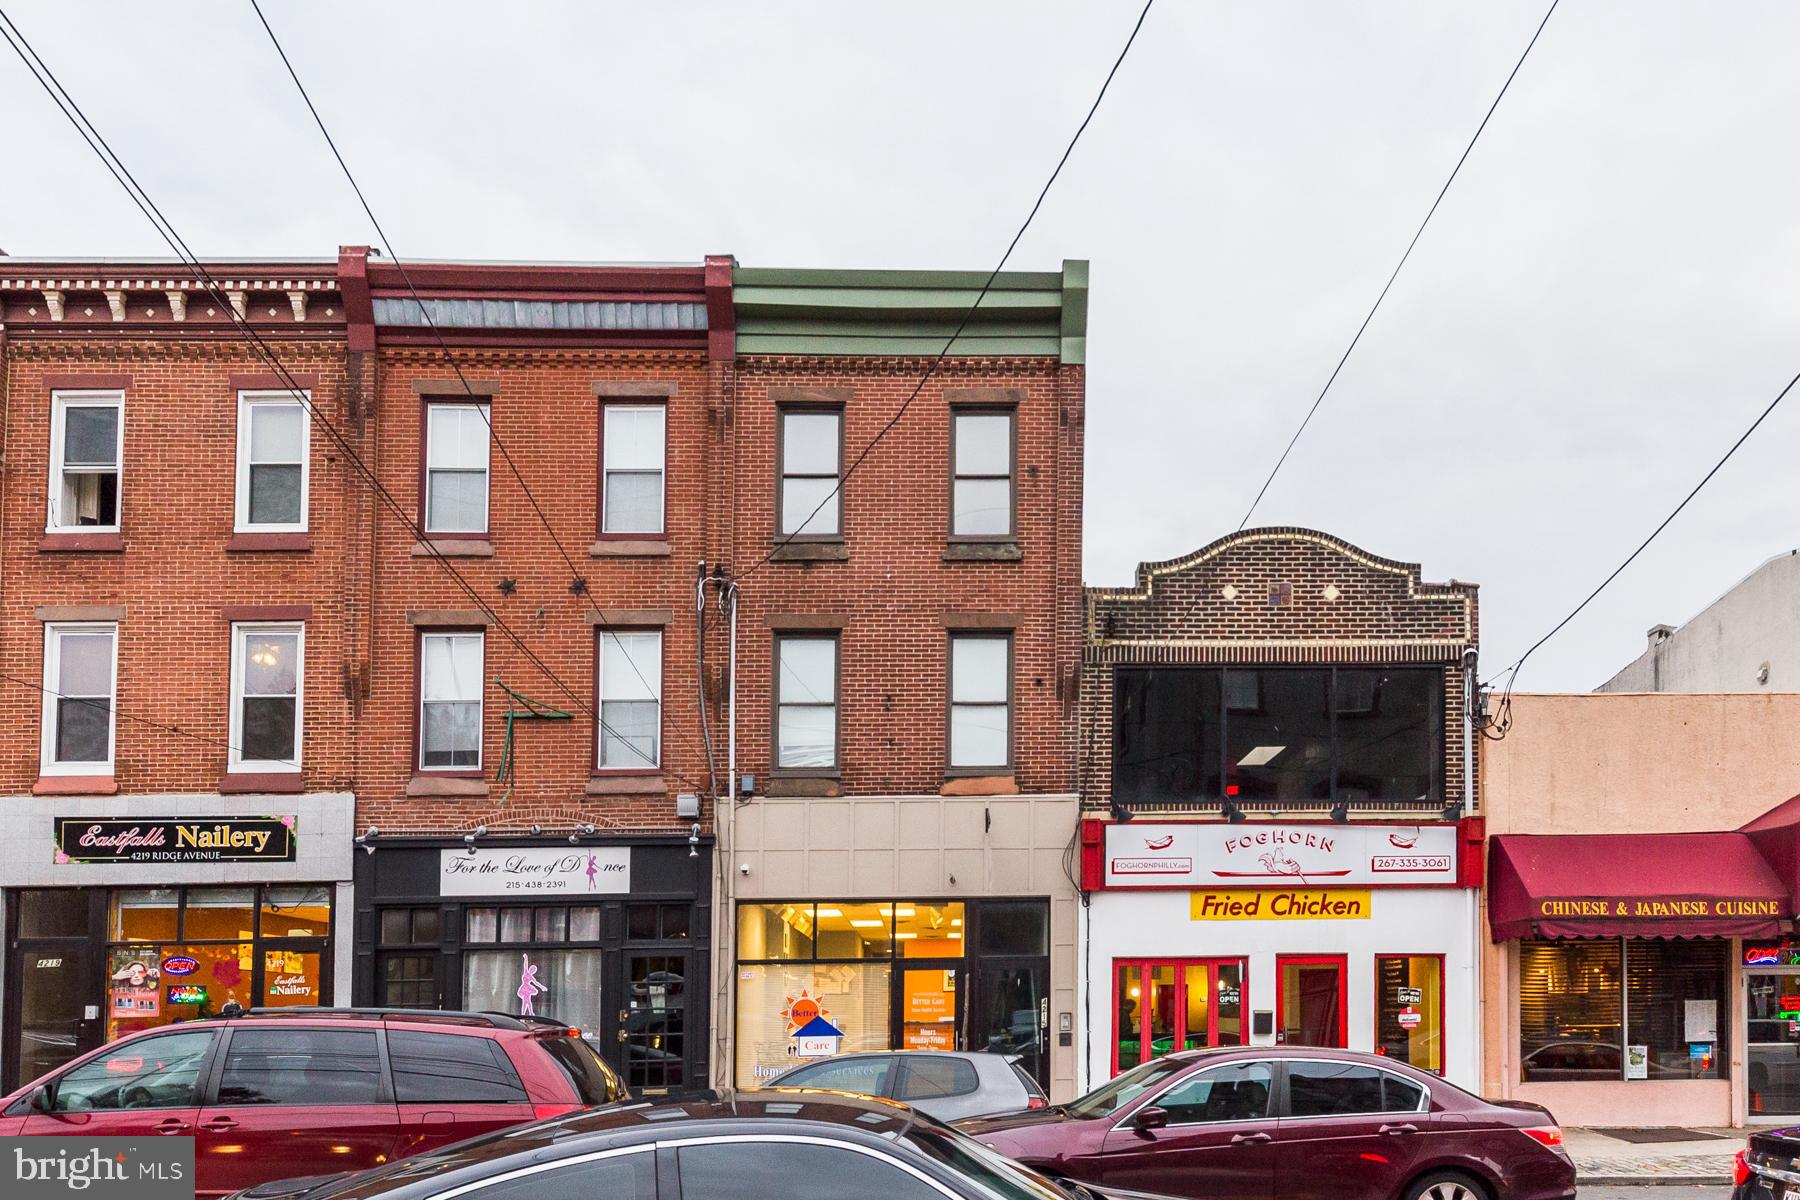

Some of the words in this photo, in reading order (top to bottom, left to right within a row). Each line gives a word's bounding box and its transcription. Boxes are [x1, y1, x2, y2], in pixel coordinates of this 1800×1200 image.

[79, 824, 166, 854] Eastfalls
[175, 824, 271, 853] Nailery
[1225, 830, 1336, 853] FOGHORN
[131, 852, 150, 860] 4219
[152, 852, 182, 860] RIDGE
[183, 852, 221, 860] AVENUE
[445, 856, 477, 874] For
[479, 859, 499, 874] the
[502, 854, 542, 874] Love
[543, 859, 559, 879] of
[559, 854, 626, 874] Dnce
[1115, 861, 1190, 870] FOGHORNPHILLY.com
[1377, 858, 1447, 868] 267-335-3061
[505, 880, 567, 889] 215-438-2391
[1201, 893, 1261, 916] Fried
[1270, 893, 1361, 916] Chicken
[1541, 901, 1609, 916] CHINESE
[1616, 902, 1628, 916] &
[1635, 901, 1709, 916] JAPANESE
[1715, 901, 1779, 916] CUISINE
[37, 959, 62, 968] 4219
[164, 962, 195, 970] OPEN
[274, 975, 305, 987] Eastfalls
[277, 985, 311, 996] Nailery
[1399, 995, 1420, 1003] OPEN
[791, 1009, 817, 1018] Better
[804, 1040, 830, 1050] Care
